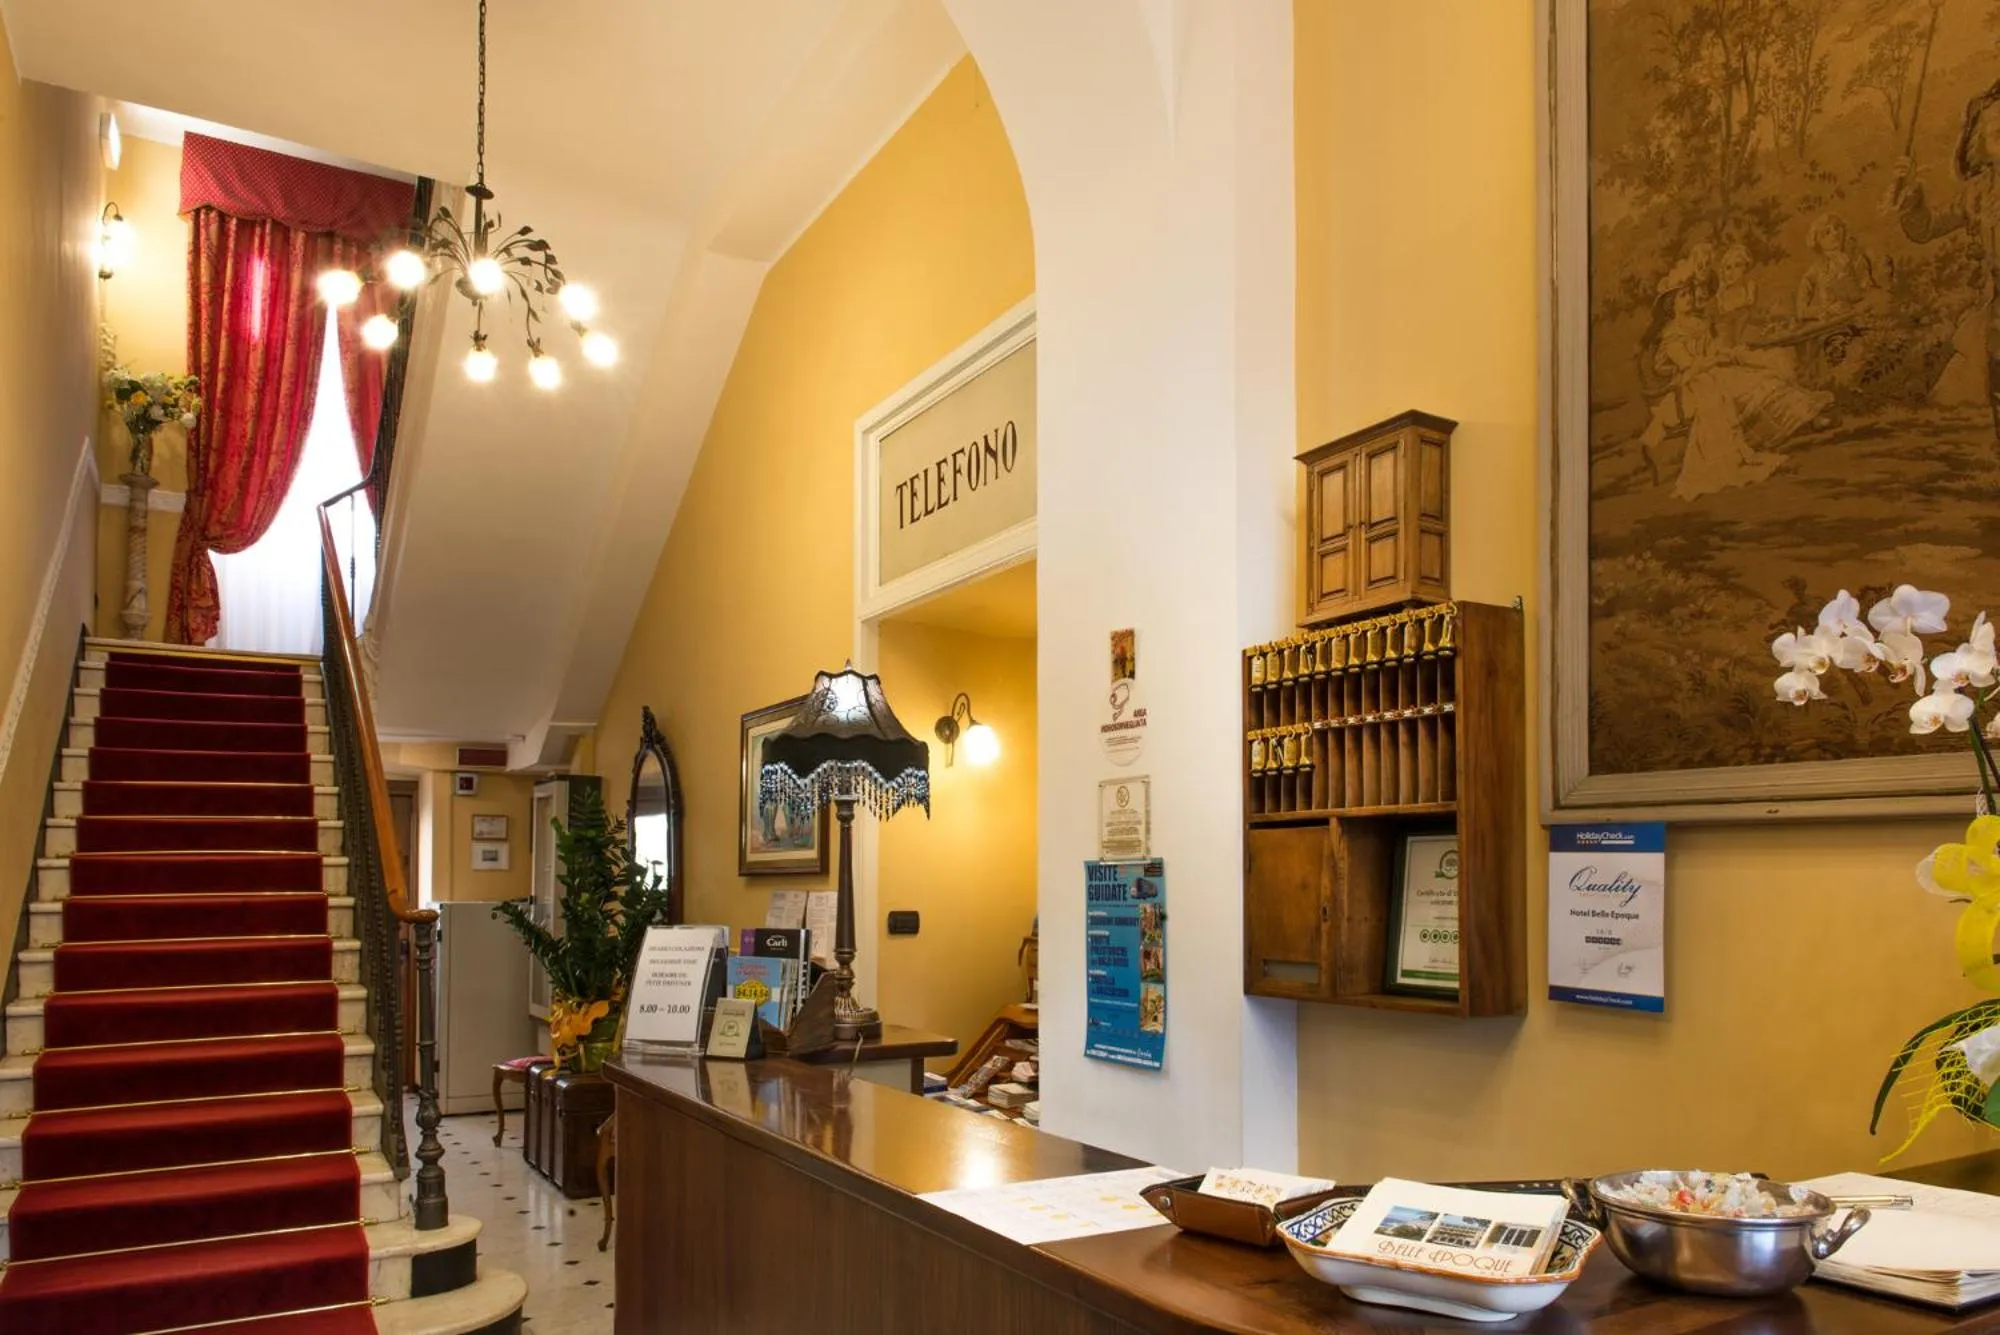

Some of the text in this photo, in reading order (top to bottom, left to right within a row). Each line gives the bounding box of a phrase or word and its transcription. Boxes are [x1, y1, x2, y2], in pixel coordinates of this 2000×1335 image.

[895, 420, 1017, 530] TELEFONO
[1088, 864, 1118, 881] VISITE
[1088, 883, 1127, 901] GUIDATE
[1569, 865, 1642, 908] Quality
[1570, 909, 1639, 920] Hotel Belle Epoque
[640, 1004, 658, 1014] 8.00
[667, 1004, 690, 1014] 10.00
[1378, 1240, 1513, 1273] BELLE EPOQUE
